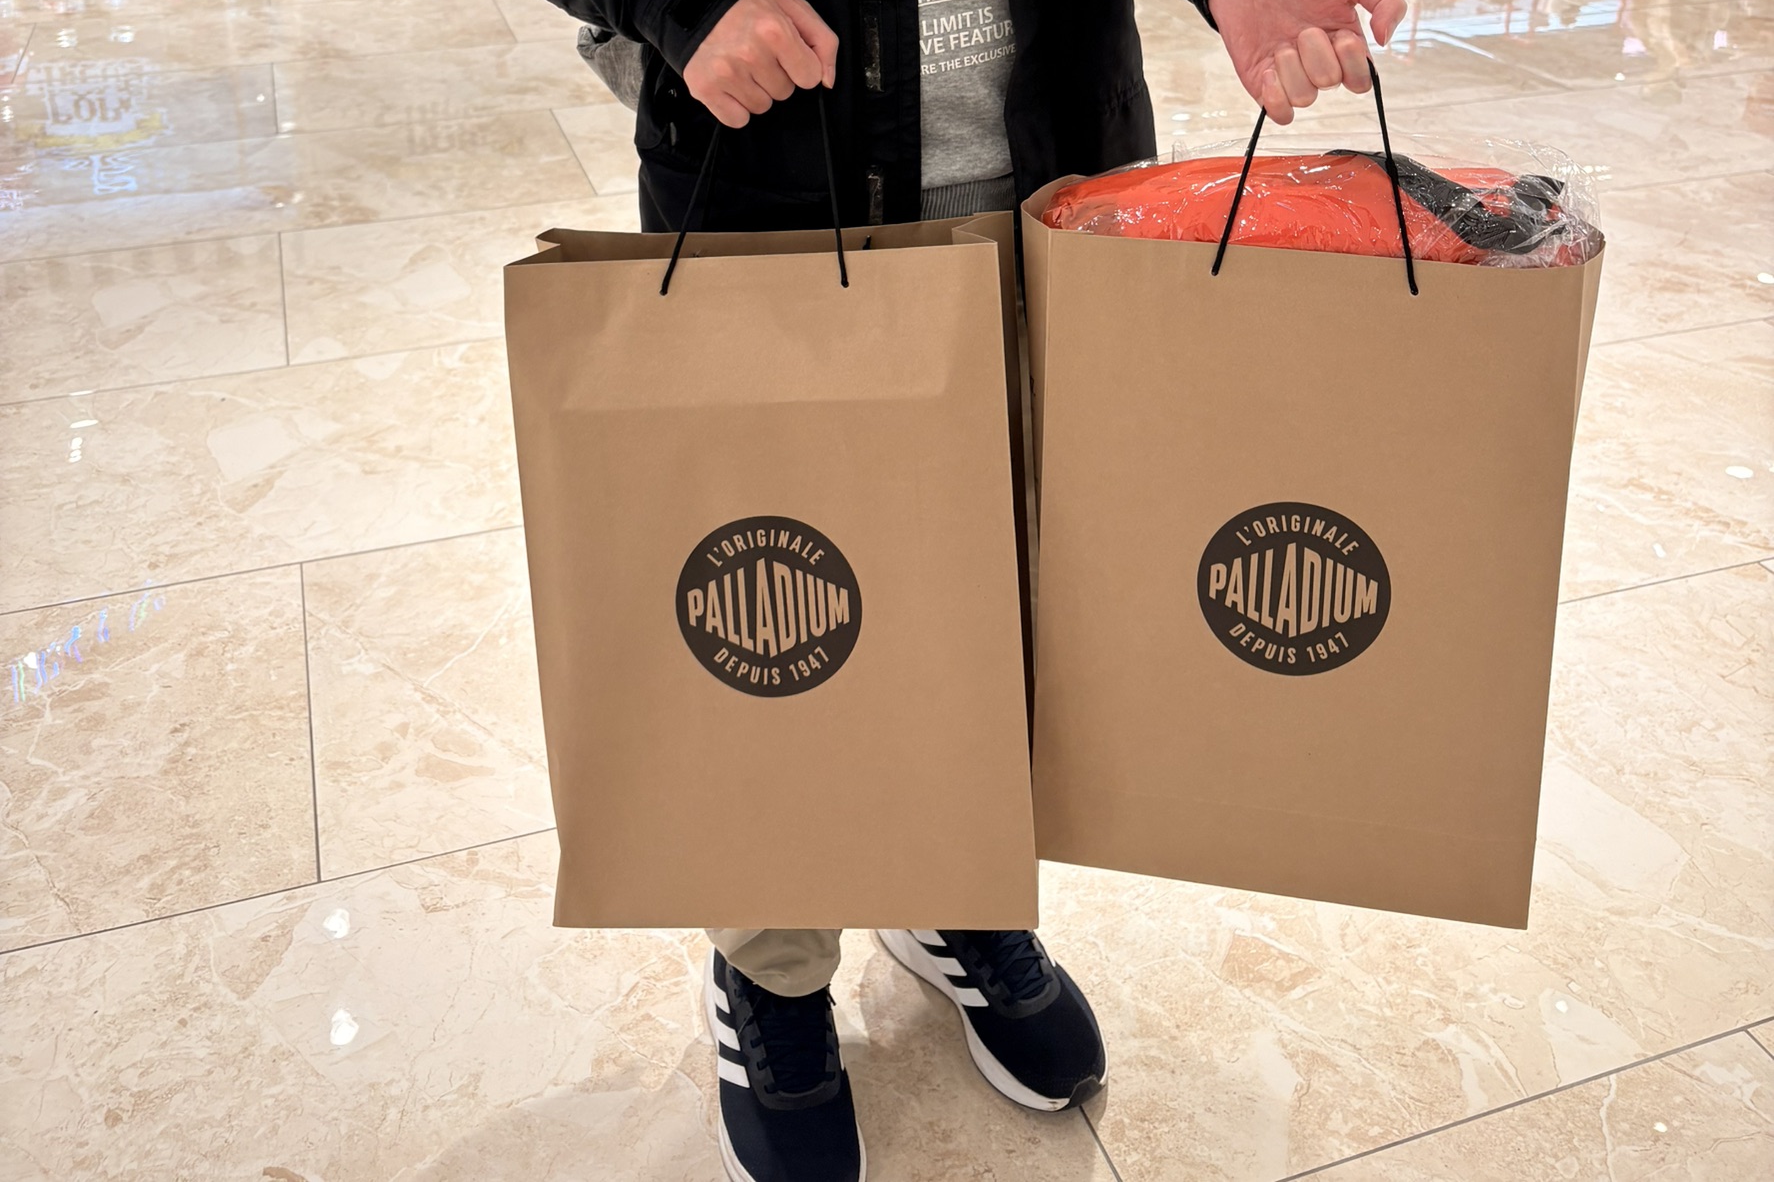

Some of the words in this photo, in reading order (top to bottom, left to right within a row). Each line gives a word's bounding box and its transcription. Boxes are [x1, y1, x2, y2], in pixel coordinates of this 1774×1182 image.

[922, 11, 974, 36] LIMIT
[978, 6, 993, 25] IS
[919, 37, 945, 55] VE
[939, 58, 962, 72] THE
[964, 43, 1016, 66] EXCLUSIVE
[706, 529, 825, 567] L'ORIGINALE
[1235, 515, 1359, 556] L'ORIGINALE
[687, 557, 850, 658] PALLADIUM
[1208, 542, 1379, 638] PALLADIUM
[1229, 622, 1297, 664] DEPUIS
[1306, 631, 1349, 663] 1947
[713, 646, 781, 685] DEPUIS
[788, 646, 829, 681] 1947
